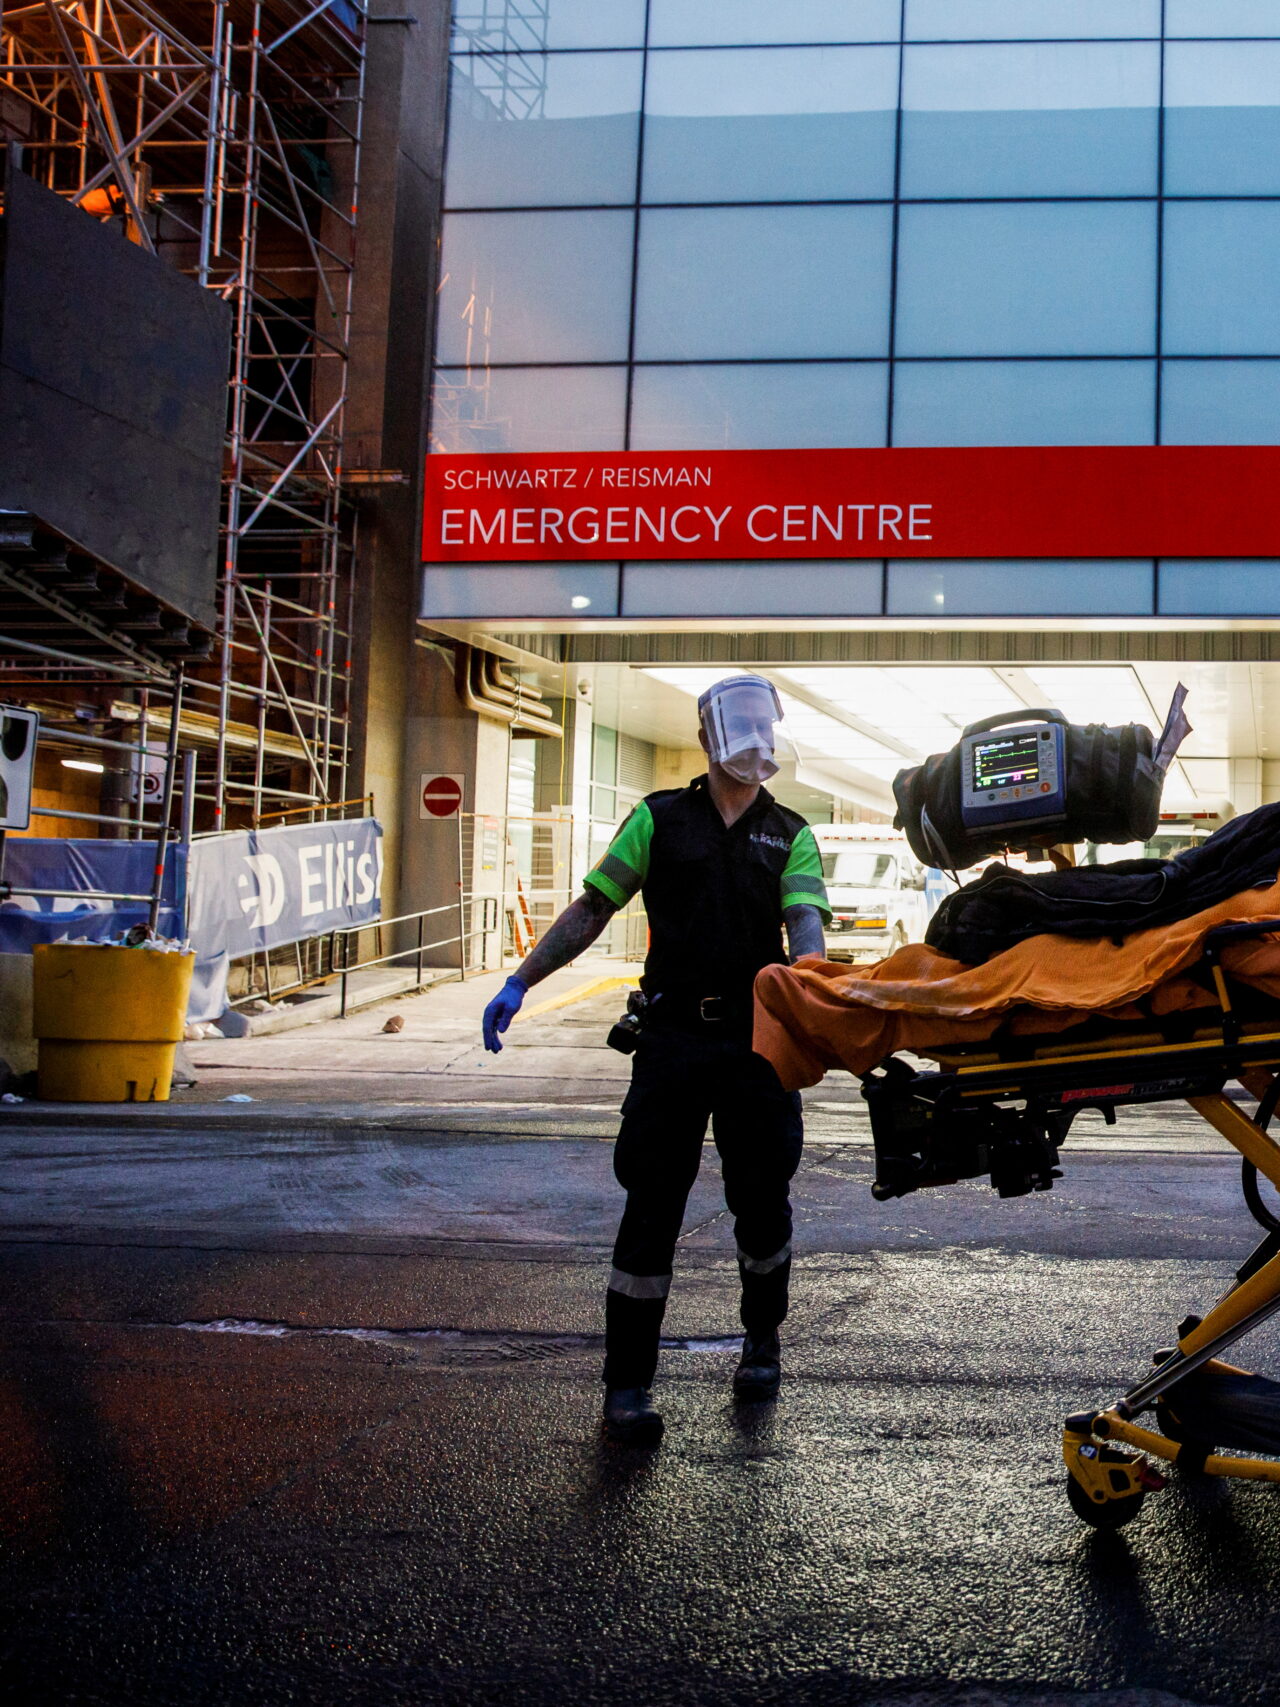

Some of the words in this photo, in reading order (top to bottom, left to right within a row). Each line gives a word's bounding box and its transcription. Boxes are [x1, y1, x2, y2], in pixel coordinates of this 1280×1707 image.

[444, 468, 577, 490] SCHWARTZ
[584, 469, 593, 489] /
[601, 467, 712, 488] REISMAN
[441, 505, 732, 544] EMERGENCY
[747, 503, 933, 542] CENTRE
